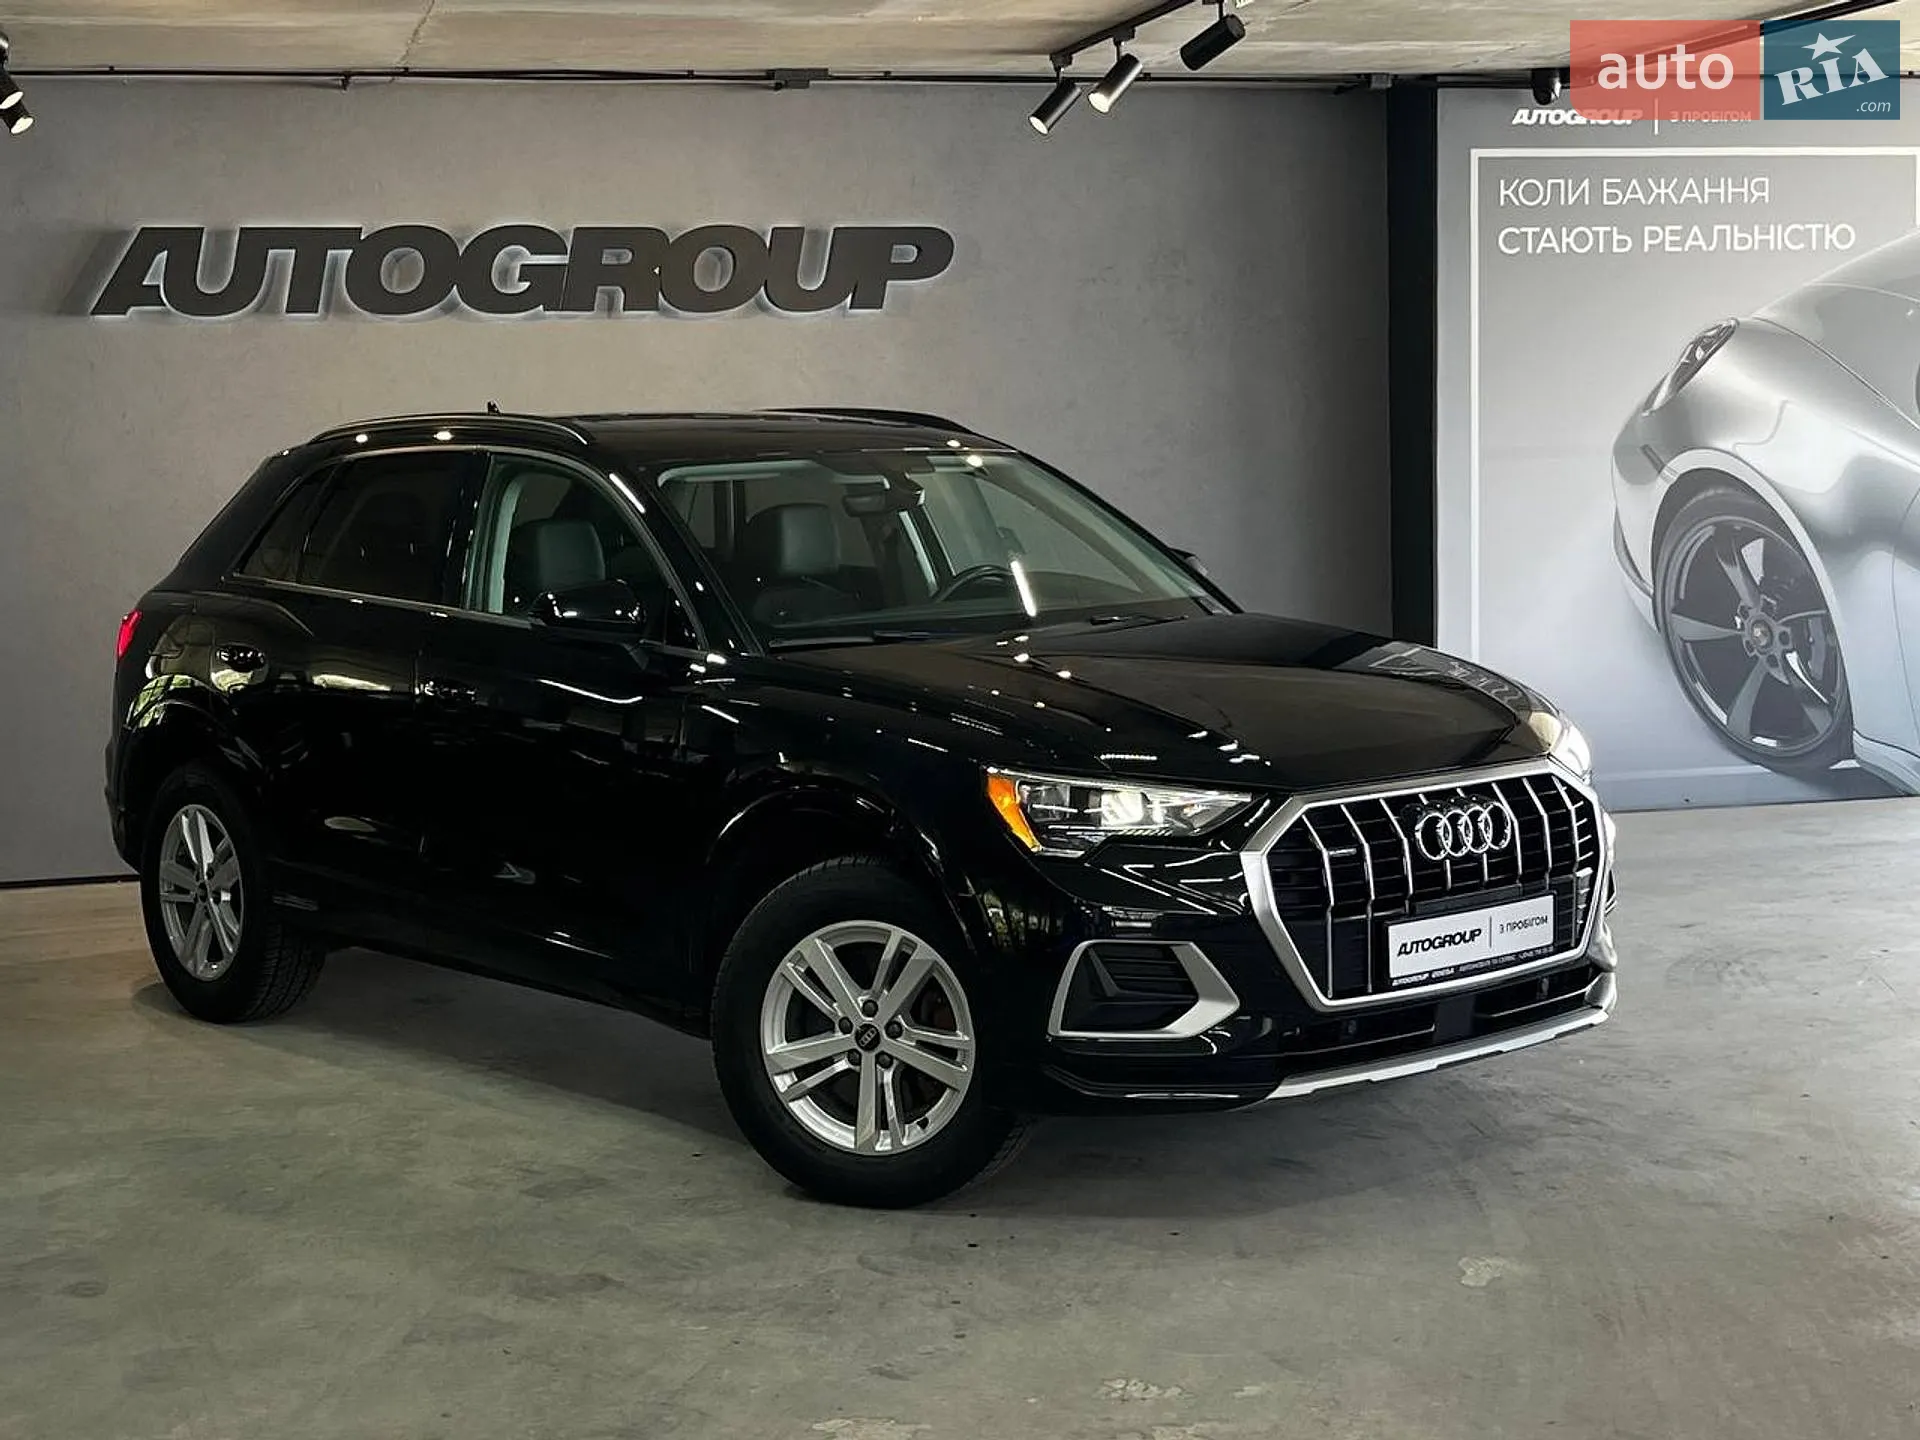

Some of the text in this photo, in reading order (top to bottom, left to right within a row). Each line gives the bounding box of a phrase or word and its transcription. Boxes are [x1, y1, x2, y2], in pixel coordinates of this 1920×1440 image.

[1512, 108, 1643, 125] AUTOGROUP
[1499, 177, 1770, 206] КОЛИ БАЖАННЯ
[1498, 224, 1856, 254] СТАЮТЬ РЕАЛЬНІСТЮ
[91, 224, 954, 317] AUTOGROUP
[1397, 928, 1482, 957] AUTOGROUP
